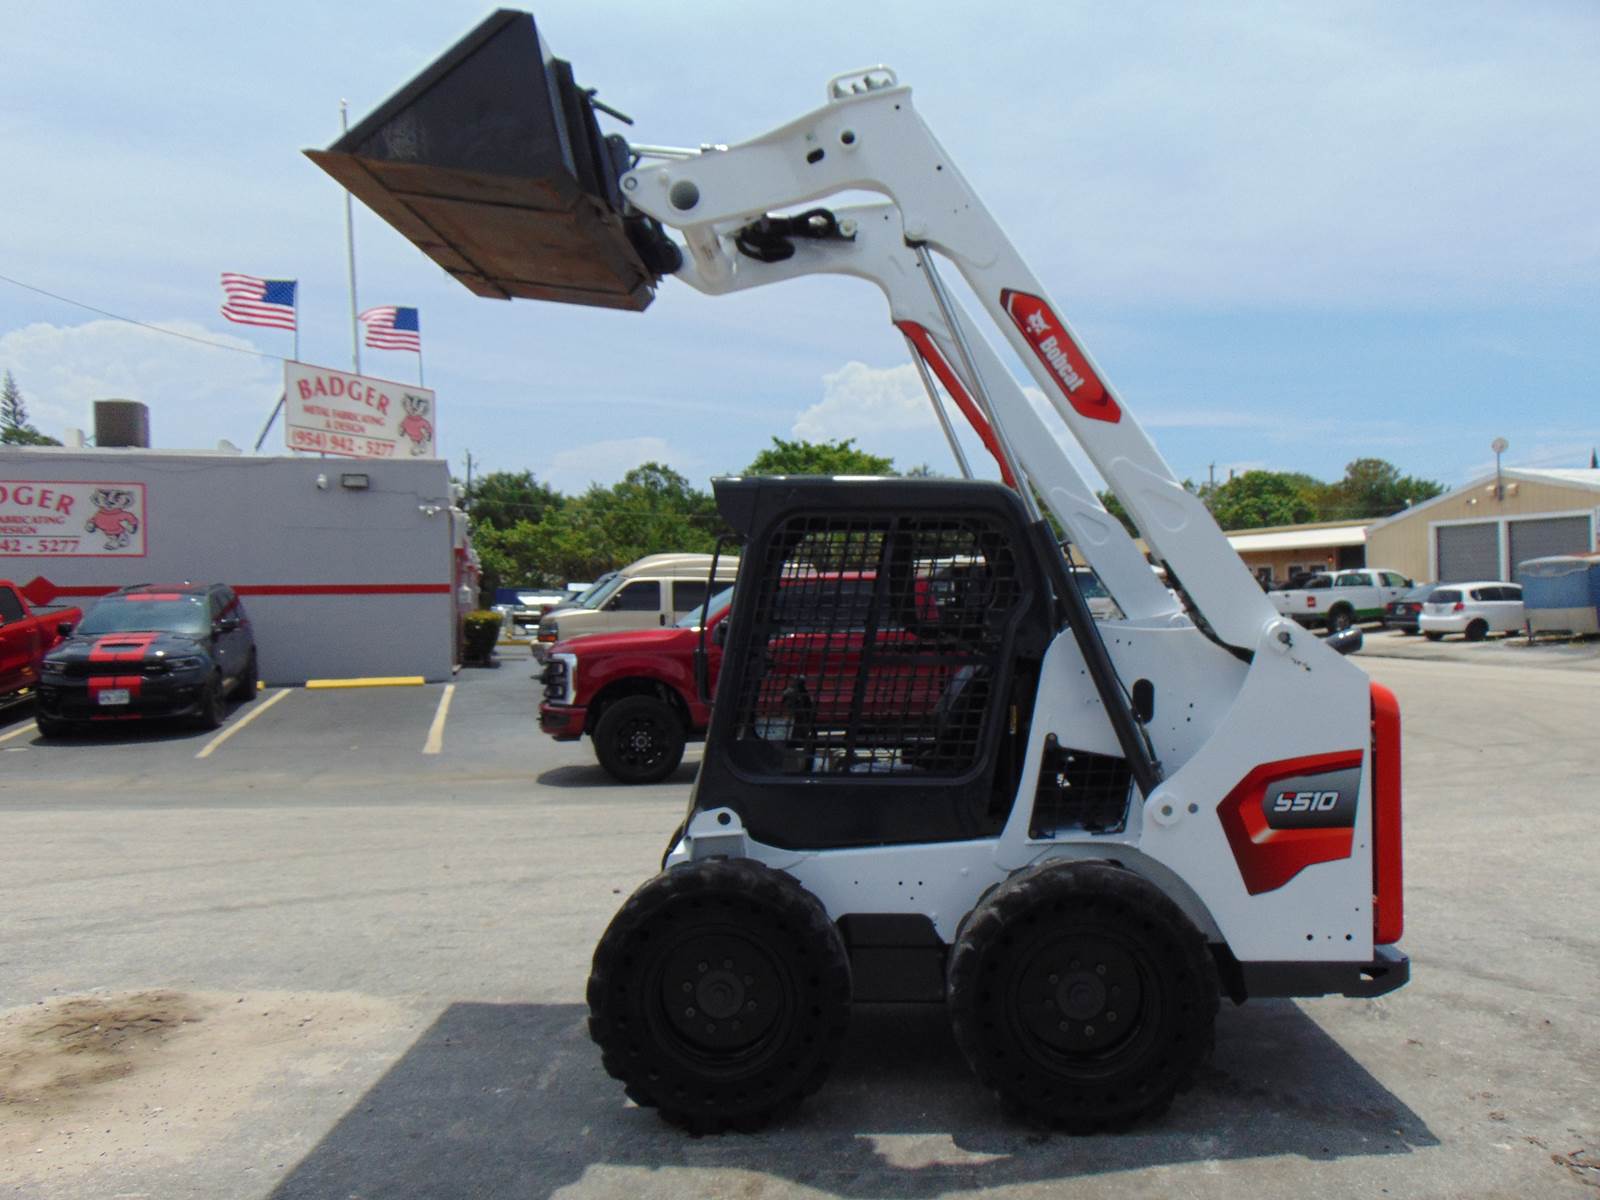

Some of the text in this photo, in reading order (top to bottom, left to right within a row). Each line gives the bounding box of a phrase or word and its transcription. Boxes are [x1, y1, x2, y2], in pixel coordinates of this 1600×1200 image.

[1039, 335, 1084, 392] Bobcat
[298, 376, 390, 416] BADGER
[330, 434, 353, 451] 942
[366, 441, 395, 456] 5277
[38, 539, 80, 552] 5277
[1273, 791, 1339, 812] S510
